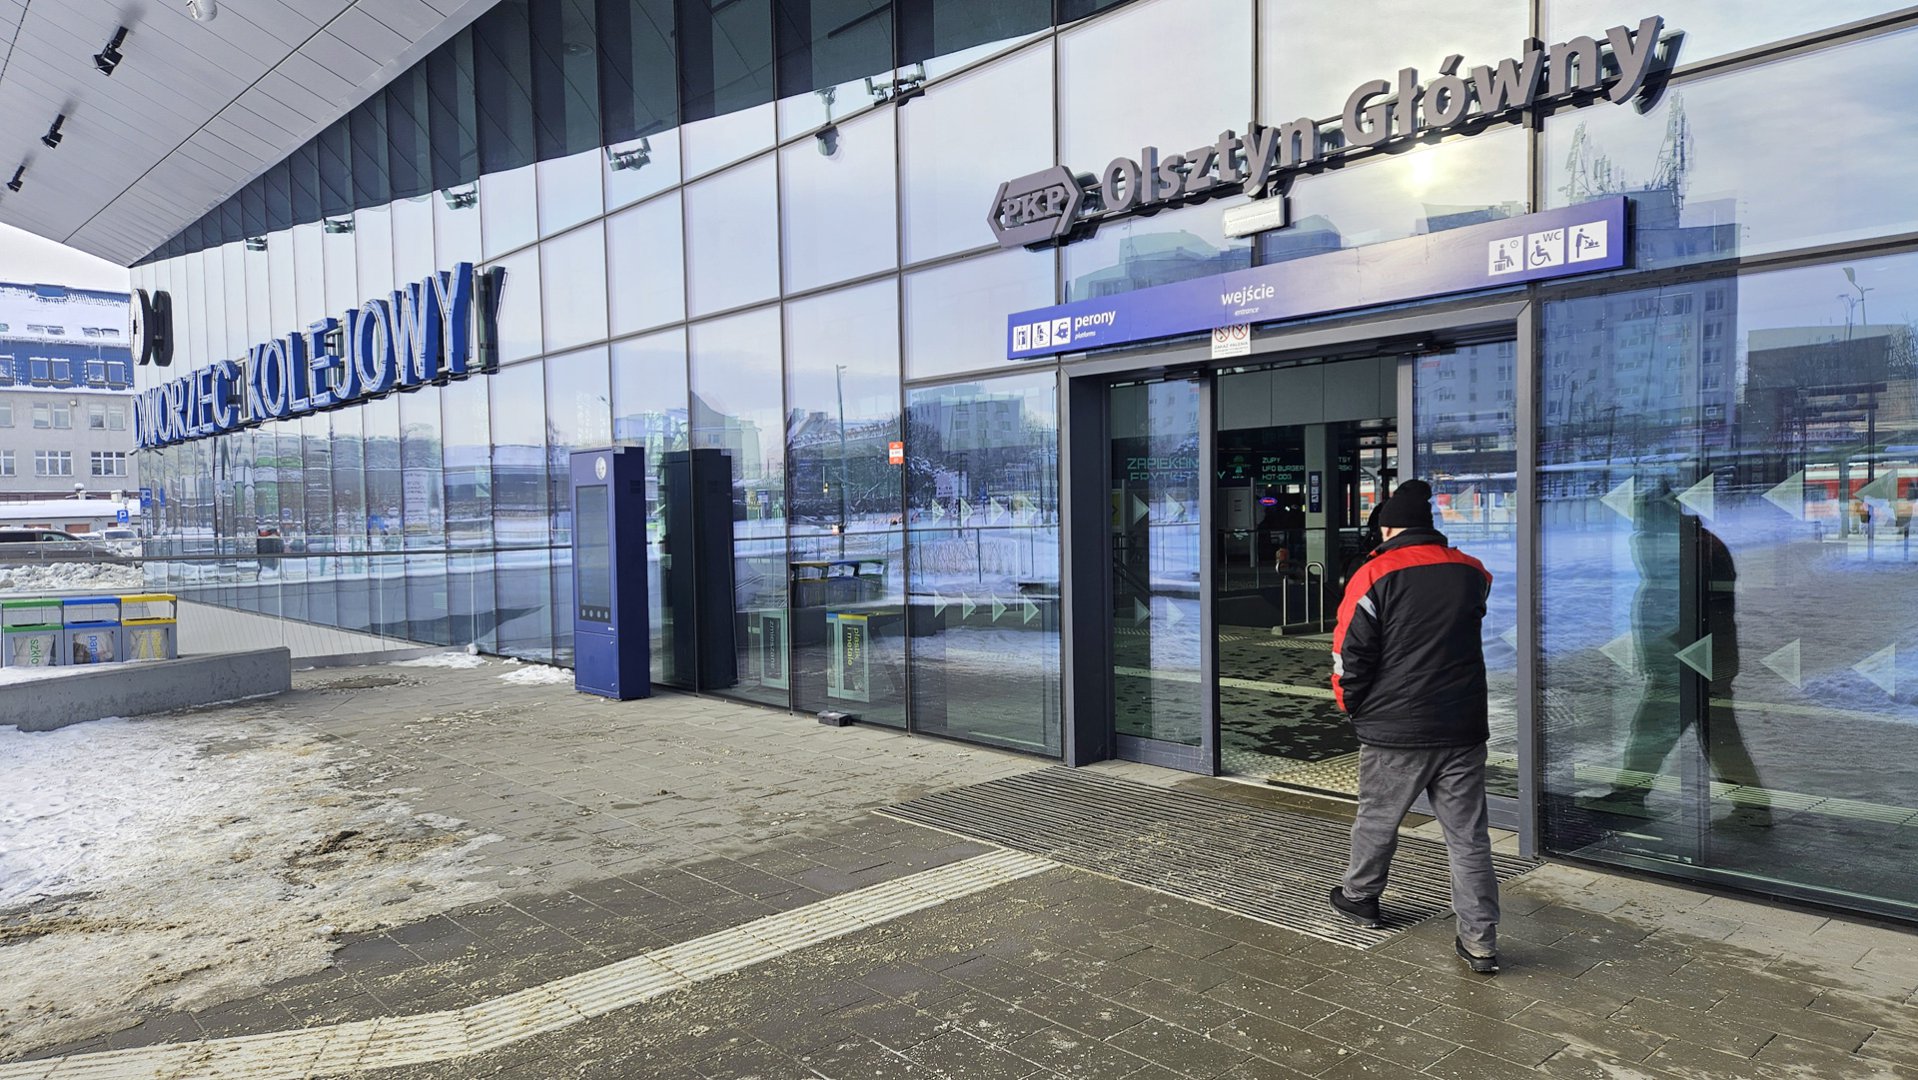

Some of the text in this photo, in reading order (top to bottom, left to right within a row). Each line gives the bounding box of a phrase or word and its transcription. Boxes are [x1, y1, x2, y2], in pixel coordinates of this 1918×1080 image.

[1102, 15, 1665, 212] Olsztyn Główny
[1002, 185, 1066, 229] PKP
[1543, 231, 1561, 242] WC
[1221, 283, 1275, 306] wejście
[1074, 310, 1116, 332] perony
[133, 262, 473, 449] DWORZEC KOLEJOWY
[1127, 457, 1199, 470] ZAPIEKAN
[120, 511, 127, 519] P
